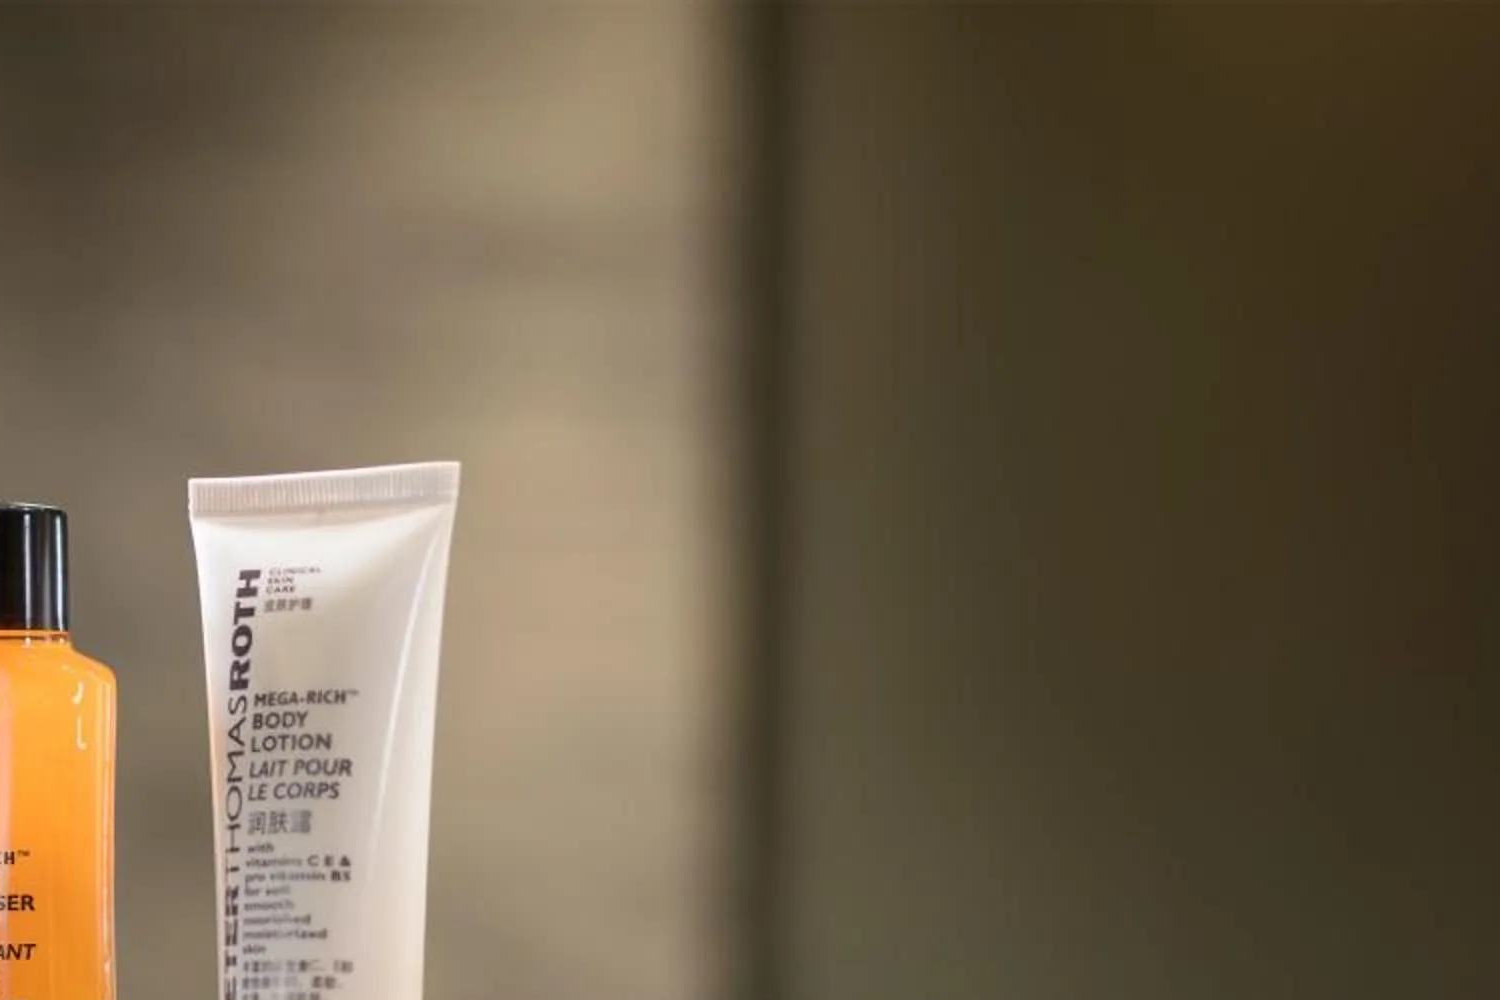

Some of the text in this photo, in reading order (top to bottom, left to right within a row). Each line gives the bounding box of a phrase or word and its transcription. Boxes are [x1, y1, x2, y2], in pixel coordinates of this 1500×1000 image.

[252, 711, 308, 730] BODY
[252, 734, 332, 752] LOTION
[249, 759, 353, 778] LAIT POUR
[248, 782, 340, 801] LE CORPS
[307, 855, 320, 867] C
